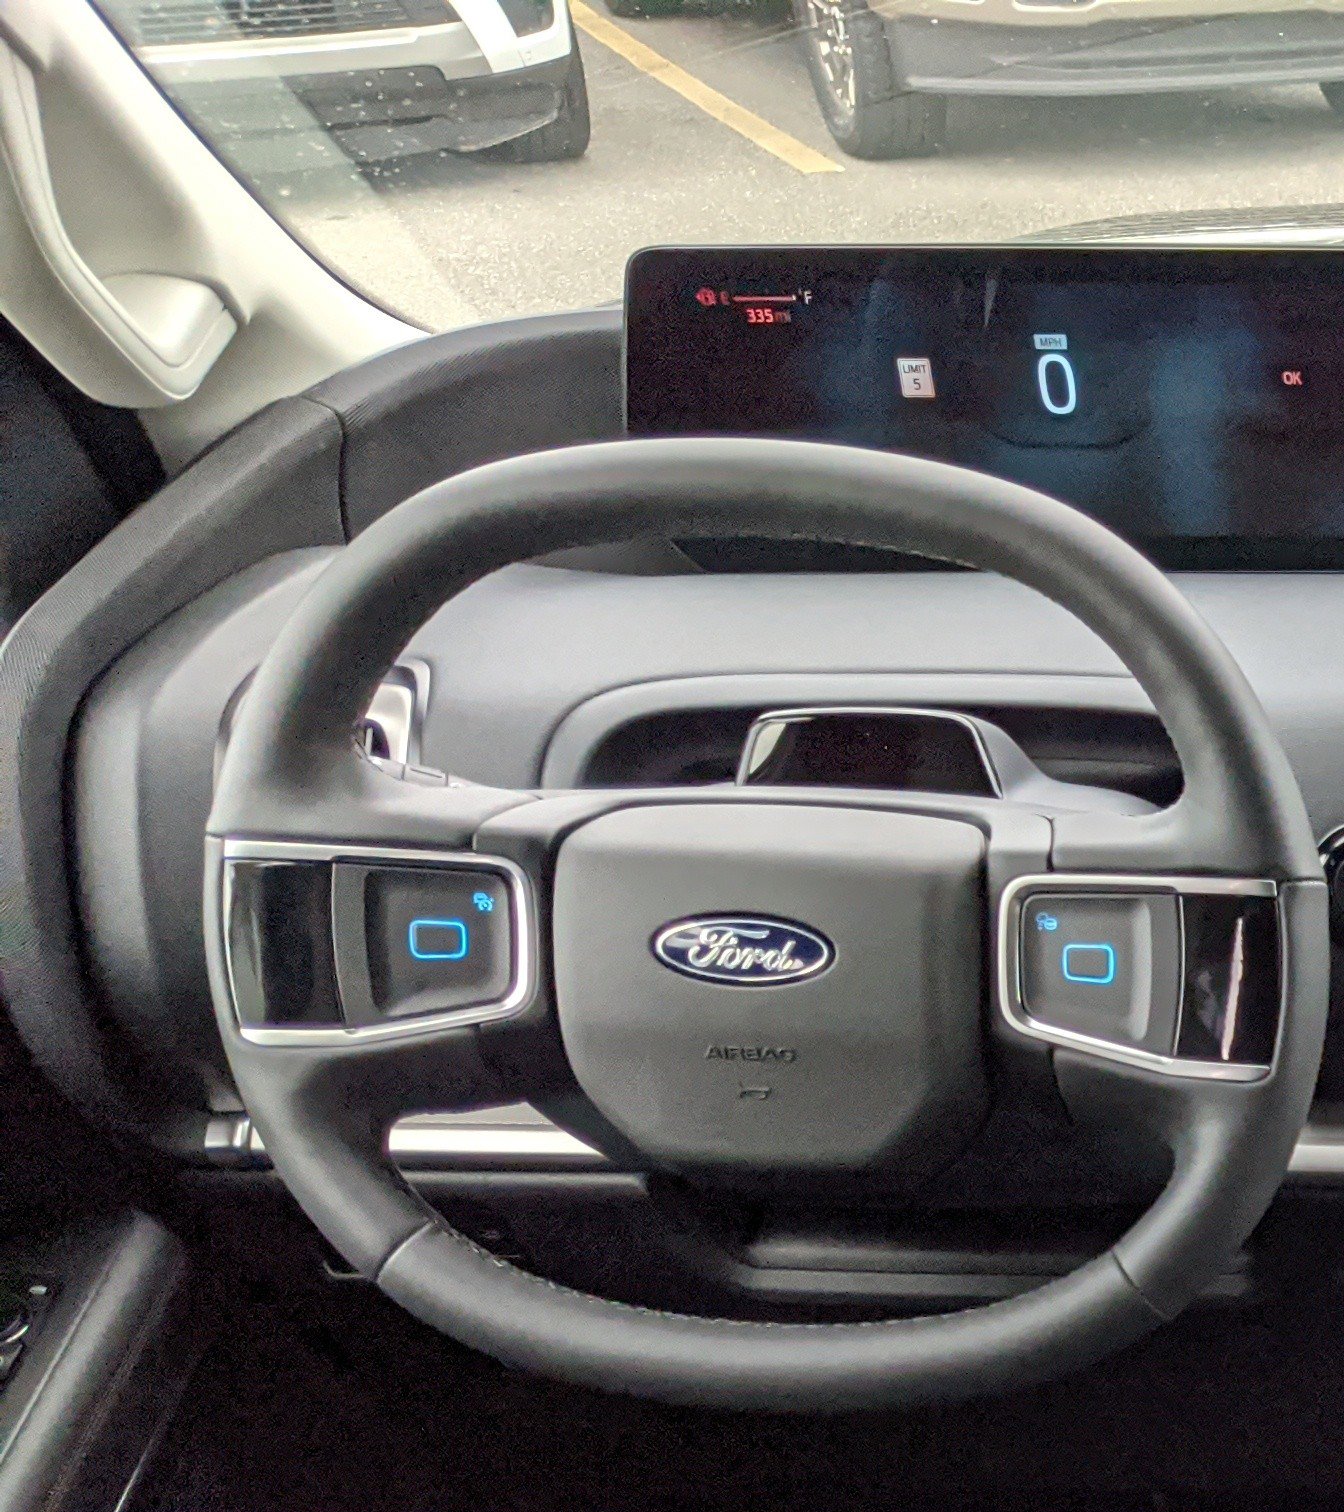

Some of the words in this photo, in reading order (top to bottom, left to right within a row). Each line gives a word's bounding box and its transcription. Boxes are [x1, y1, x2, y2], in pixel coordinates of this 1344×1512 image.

[746, 308, 774, 323] 335
[1039, 337, 1062, 347] MPH
[902, 364, 927, 374] LIMIT
[912, 378, 922, 391] 5
[1037, 353, 1077, 415] 0
[1282, 372, 1303, 386] OK
[689, 925, 805, 972] Ford
